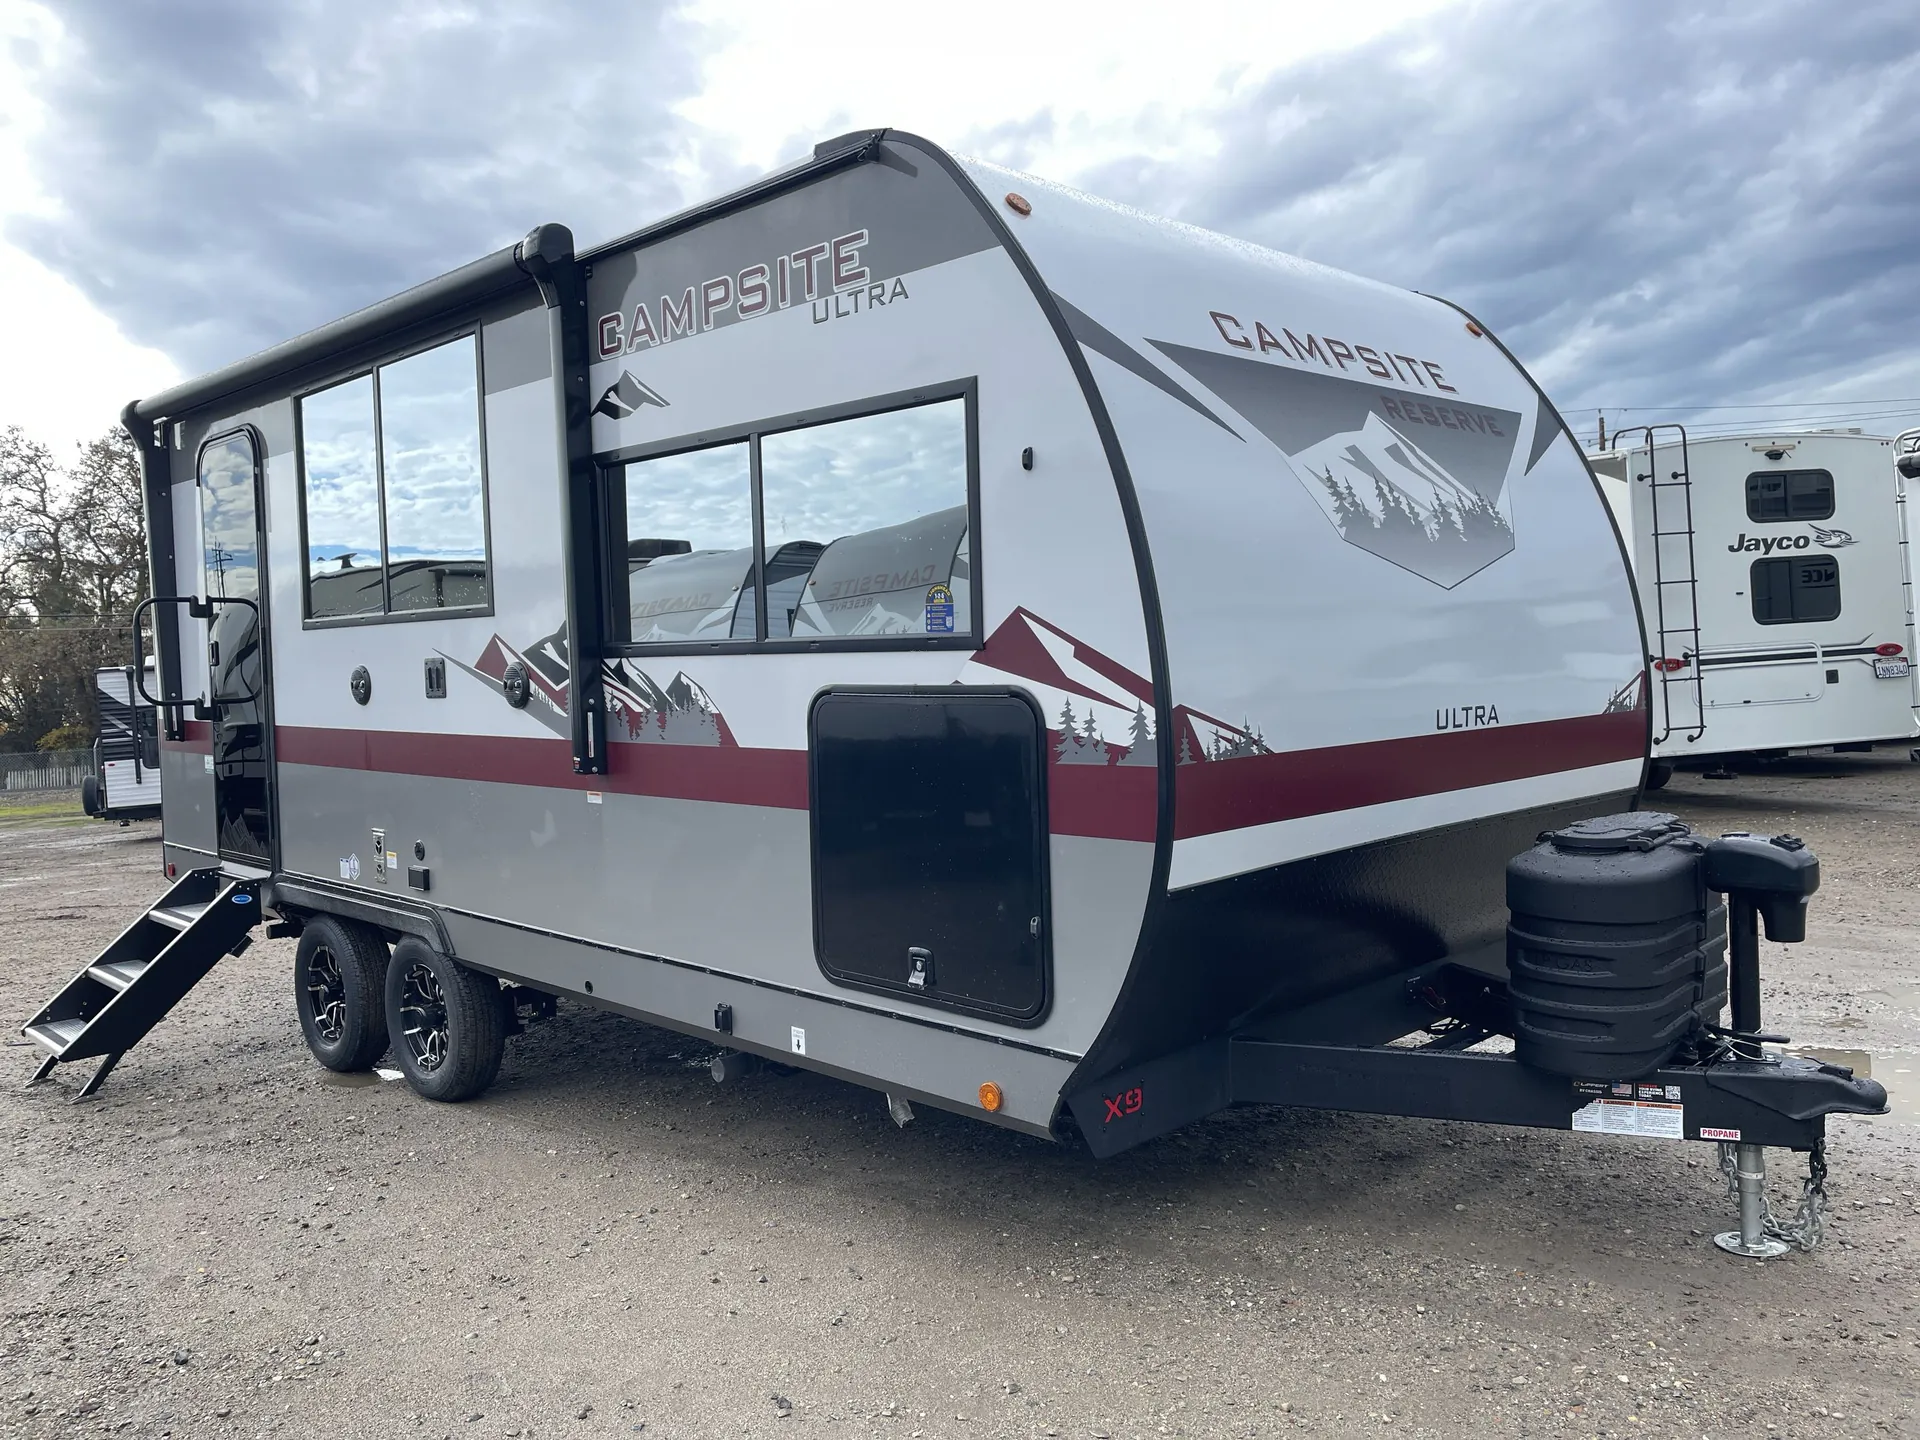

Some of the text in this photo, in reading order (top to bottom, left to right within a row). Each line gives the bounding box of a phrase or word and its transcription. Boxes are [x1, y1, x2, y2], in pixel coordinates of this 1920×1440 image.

[599, 229, 868, 361] CAMPSITE
[813, 277, 909, 325] ULTRA
[1209, 311, 1459, 394] CAMPSITE
[1380, 395, 1506, 437] RESERVE
[1728, 533, 1810, 555] Jayco
[1437, 704, 1499, 730] ULTRA
[1557, 956, 1593, 972] GAS
[1104, 1088, 1143, 1123] X9
[1702, 1129, 1739, 1139] PROPANE
